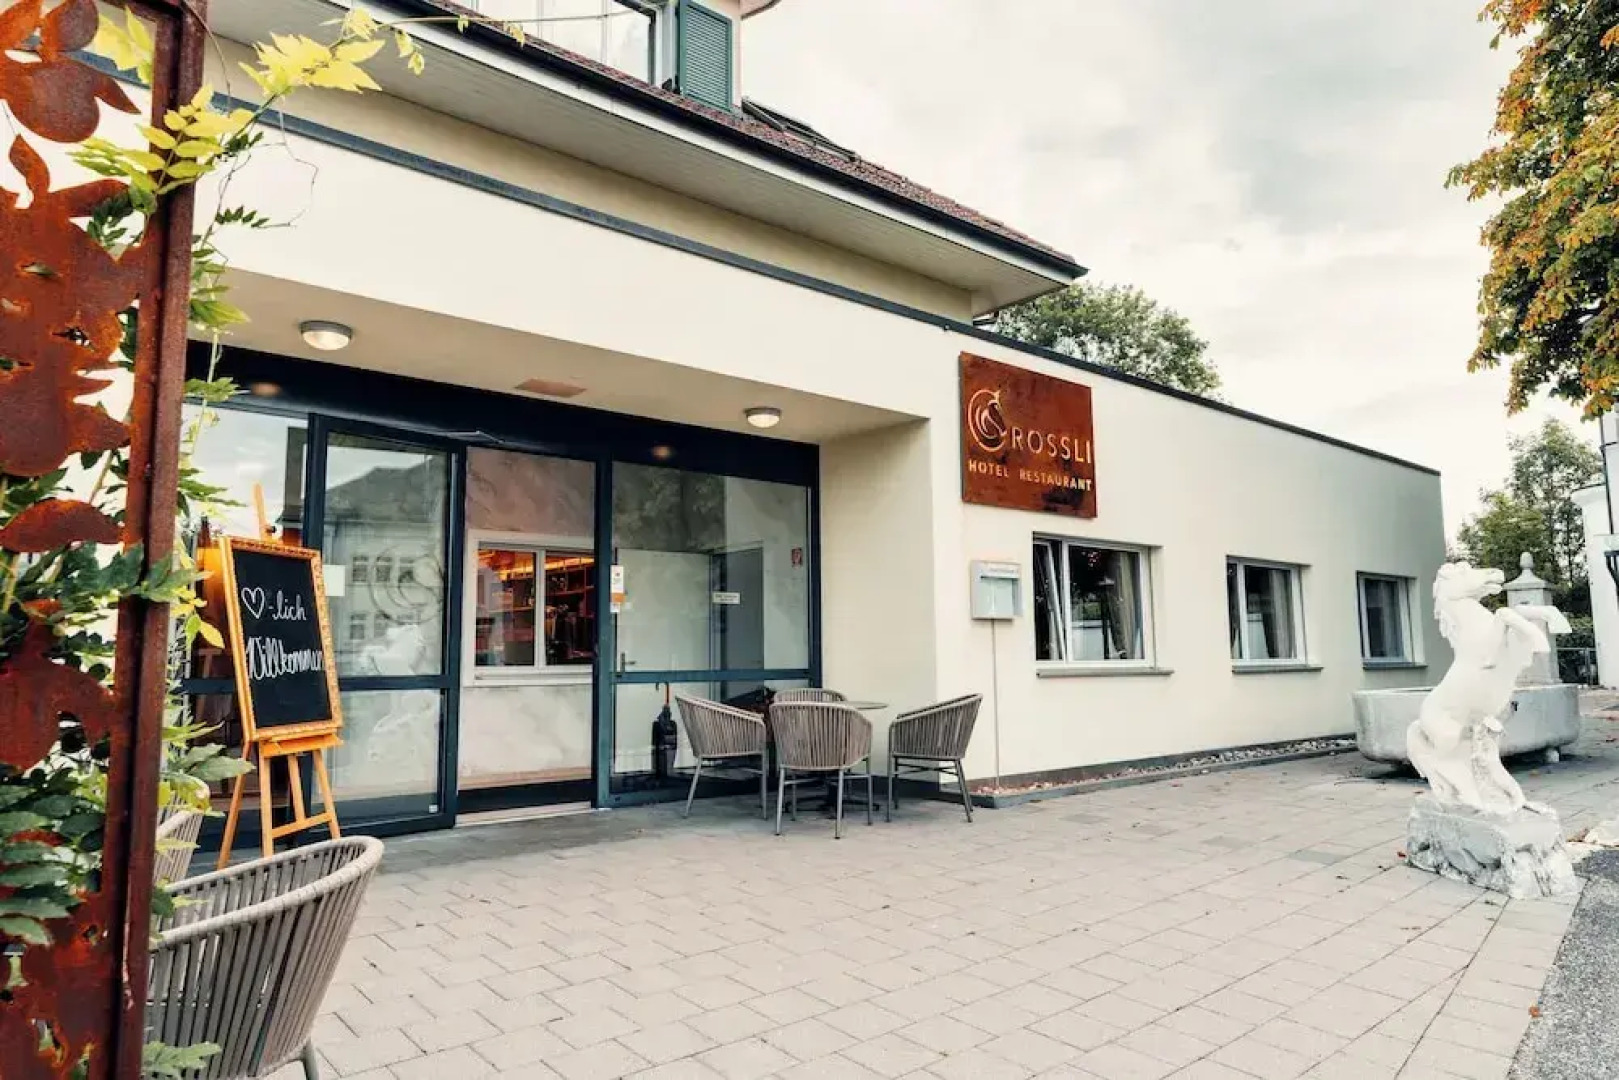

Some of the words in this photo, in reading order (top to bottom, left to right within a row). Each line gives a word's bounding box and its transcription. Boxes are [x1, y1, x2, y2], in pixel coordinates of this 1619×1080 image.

[1011, 426, 1092, 464] ROSSLI
[968, 459, 1009, 477] HOTEL
[1019, 468, 1092, 491] RESTAURANT
